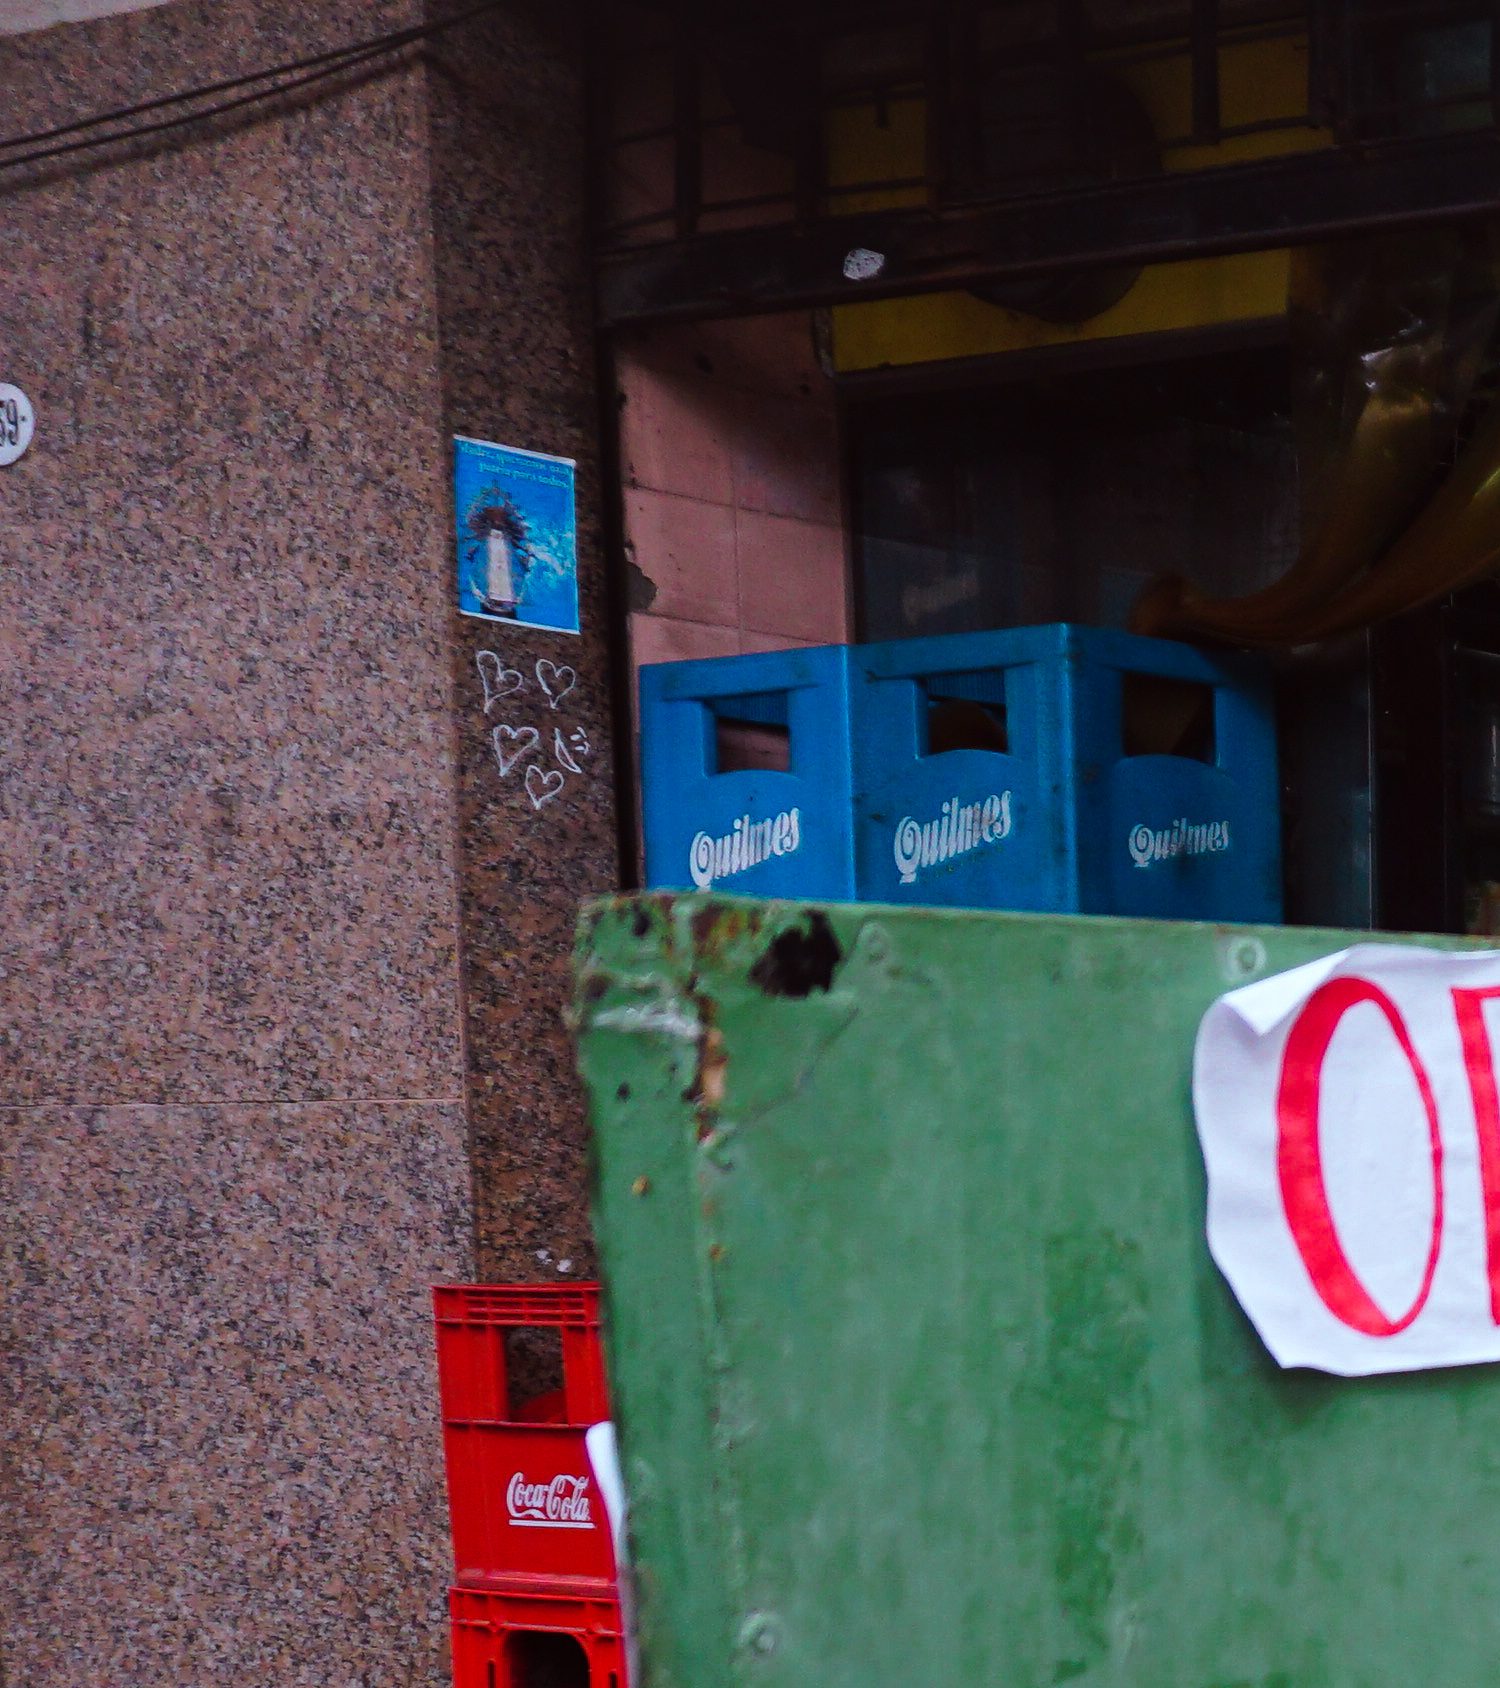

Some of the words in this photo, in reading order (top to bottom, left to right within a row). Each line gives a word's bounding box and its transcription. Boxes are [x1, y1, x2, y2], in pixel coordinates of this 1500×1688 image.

[690, 806, 800, 890] Quilmes
[894, 790, 1012, 884] Quilmes
[1128, 818, 1230, 868] Quilmes
[506, 1471, 592, 1521] Coca-Cola
